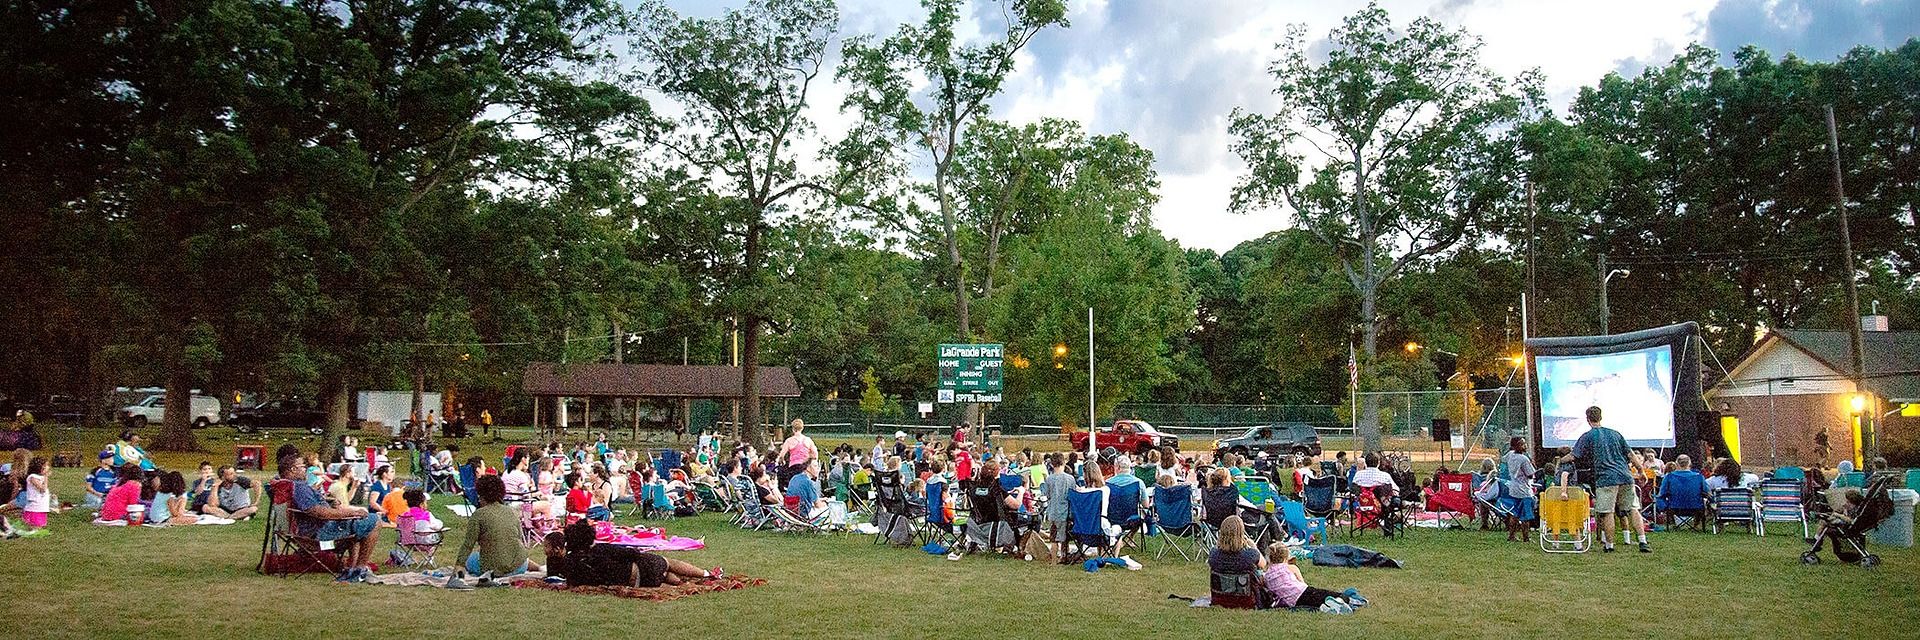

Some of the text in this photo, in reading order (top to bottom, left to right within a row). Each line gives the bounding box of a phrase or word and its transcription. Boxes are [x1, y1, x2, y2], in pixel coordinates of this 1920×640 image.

[941, 347, 1000, 357] LaGrande Park
[977, 393, 1001, 402] Baseball
